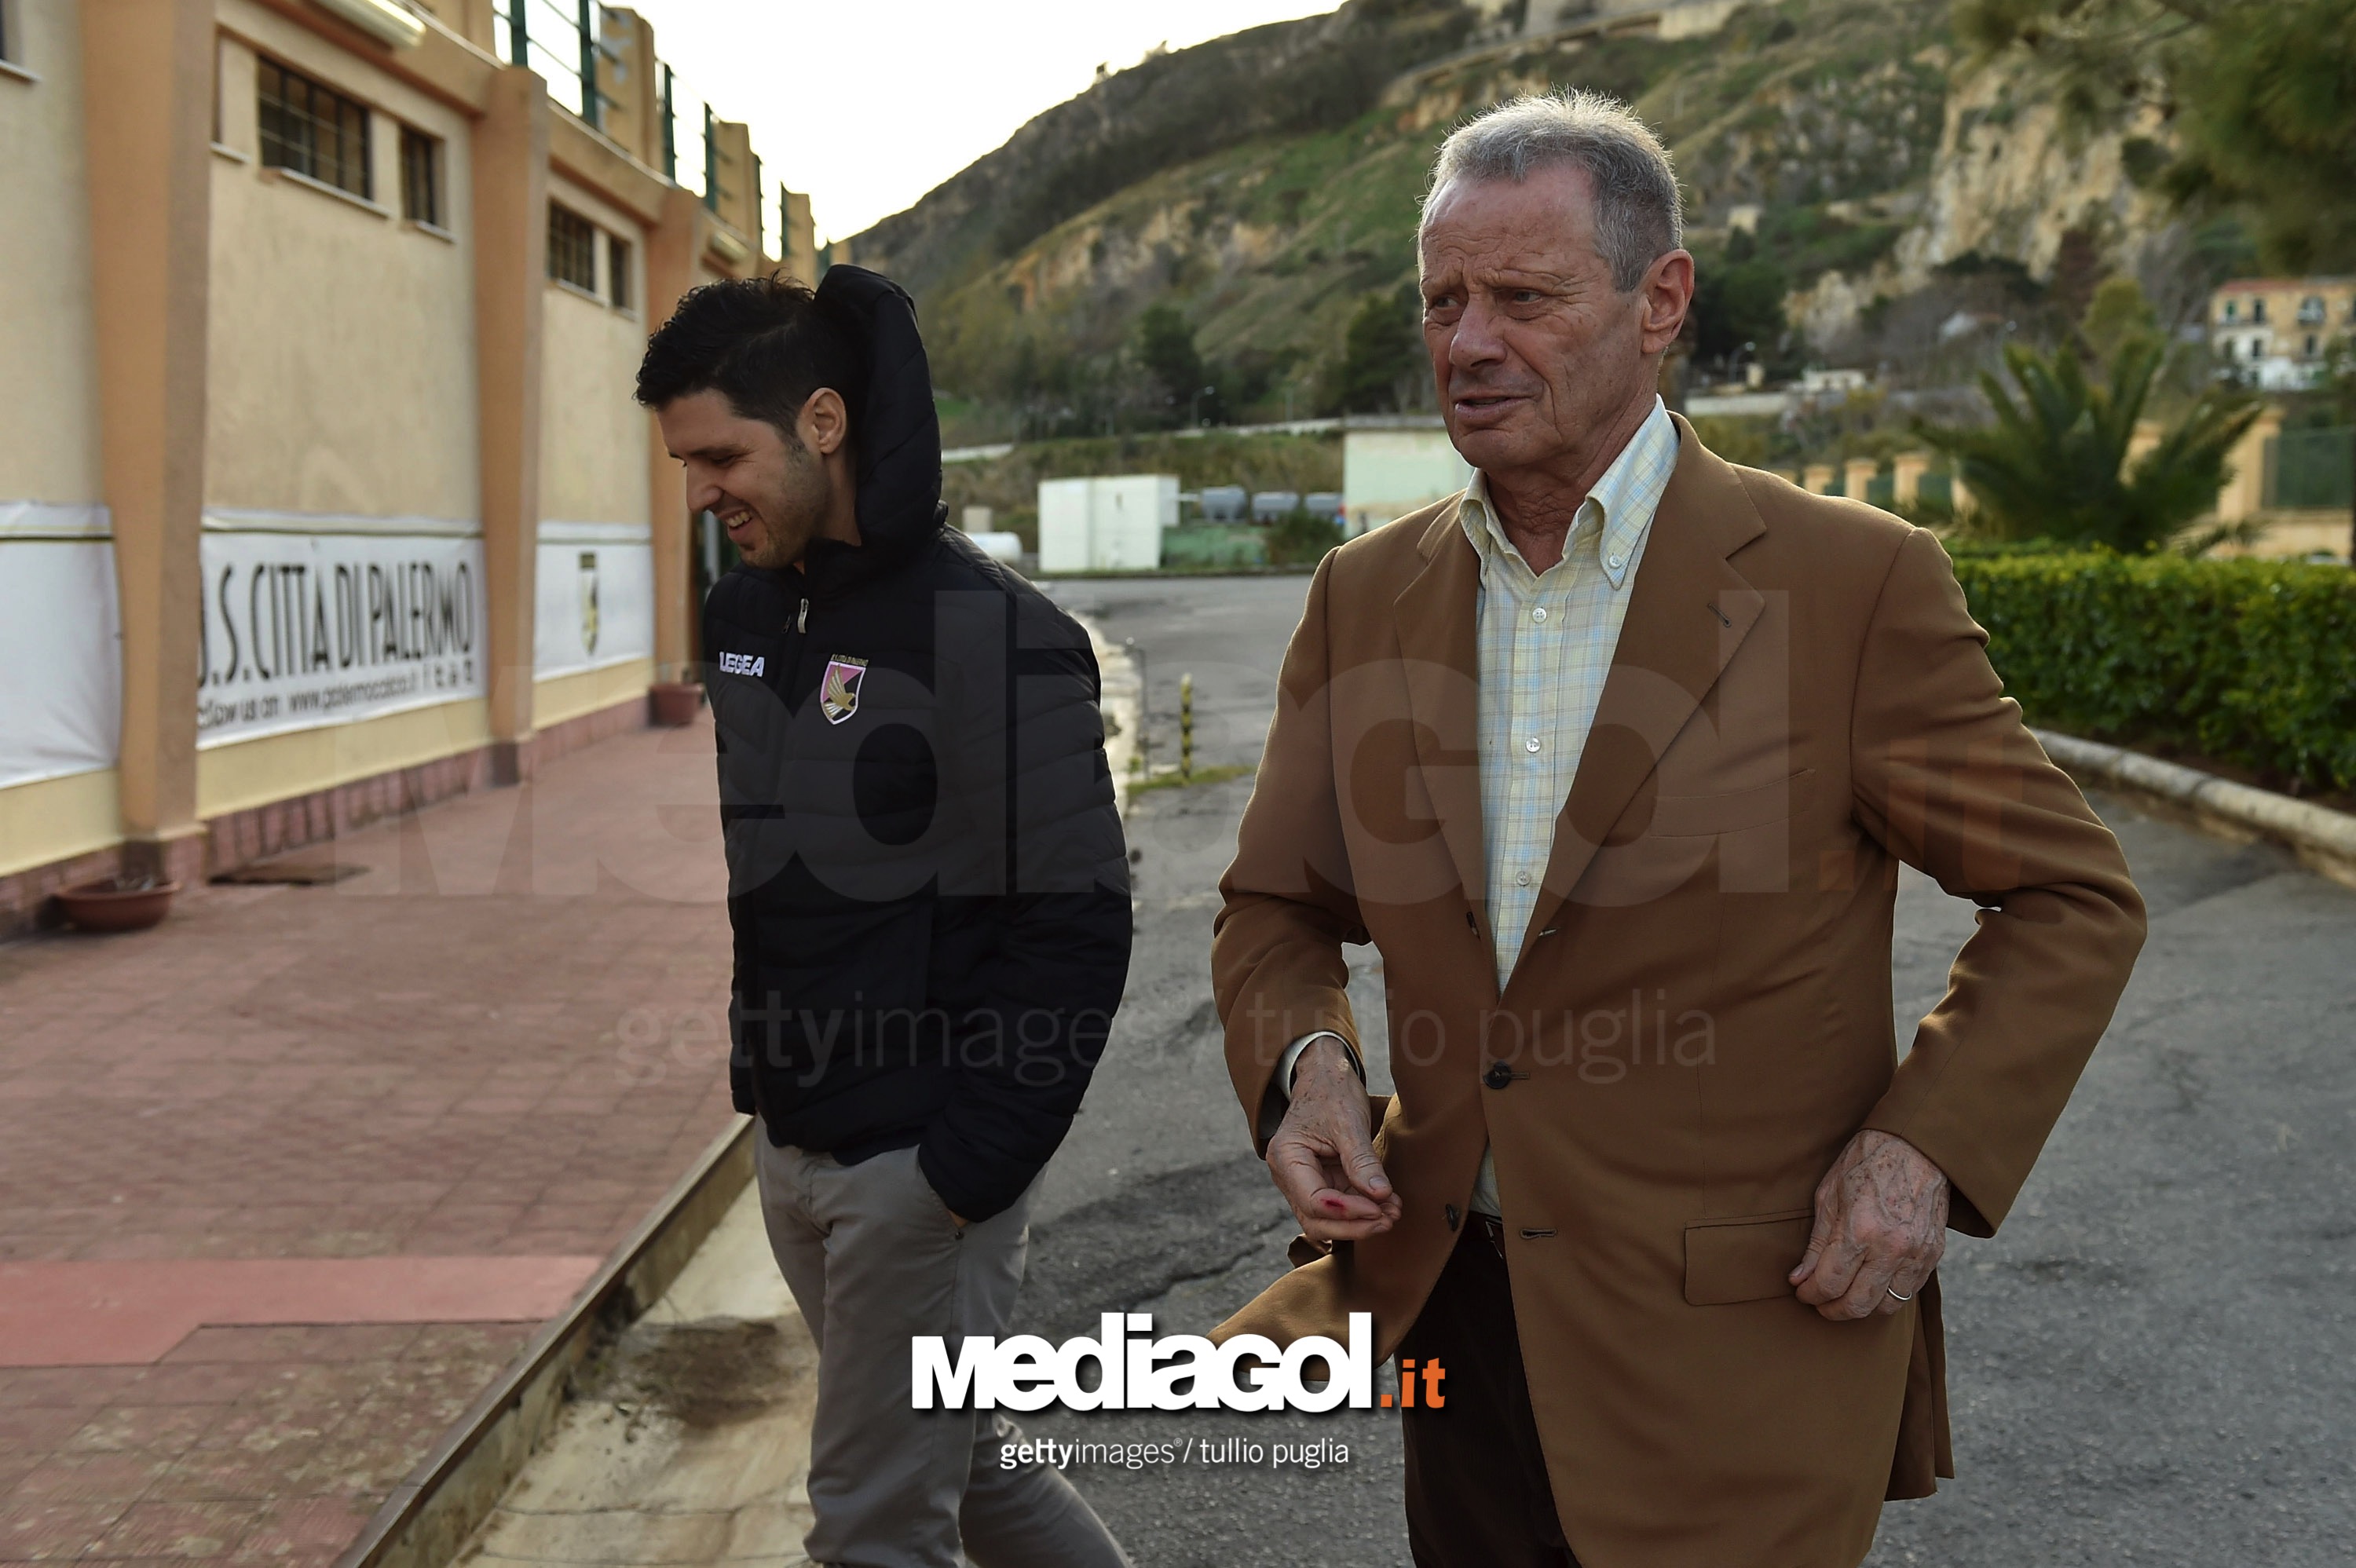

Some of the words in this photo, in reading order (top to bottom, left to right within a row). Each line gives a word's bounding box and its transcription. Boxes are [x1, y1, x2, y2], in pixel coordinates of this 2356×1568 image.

[335, 563, 364, 669] DI
[368, 561, 474, 664] PALERMO
[719, 651, 765, 678] LEGEA
